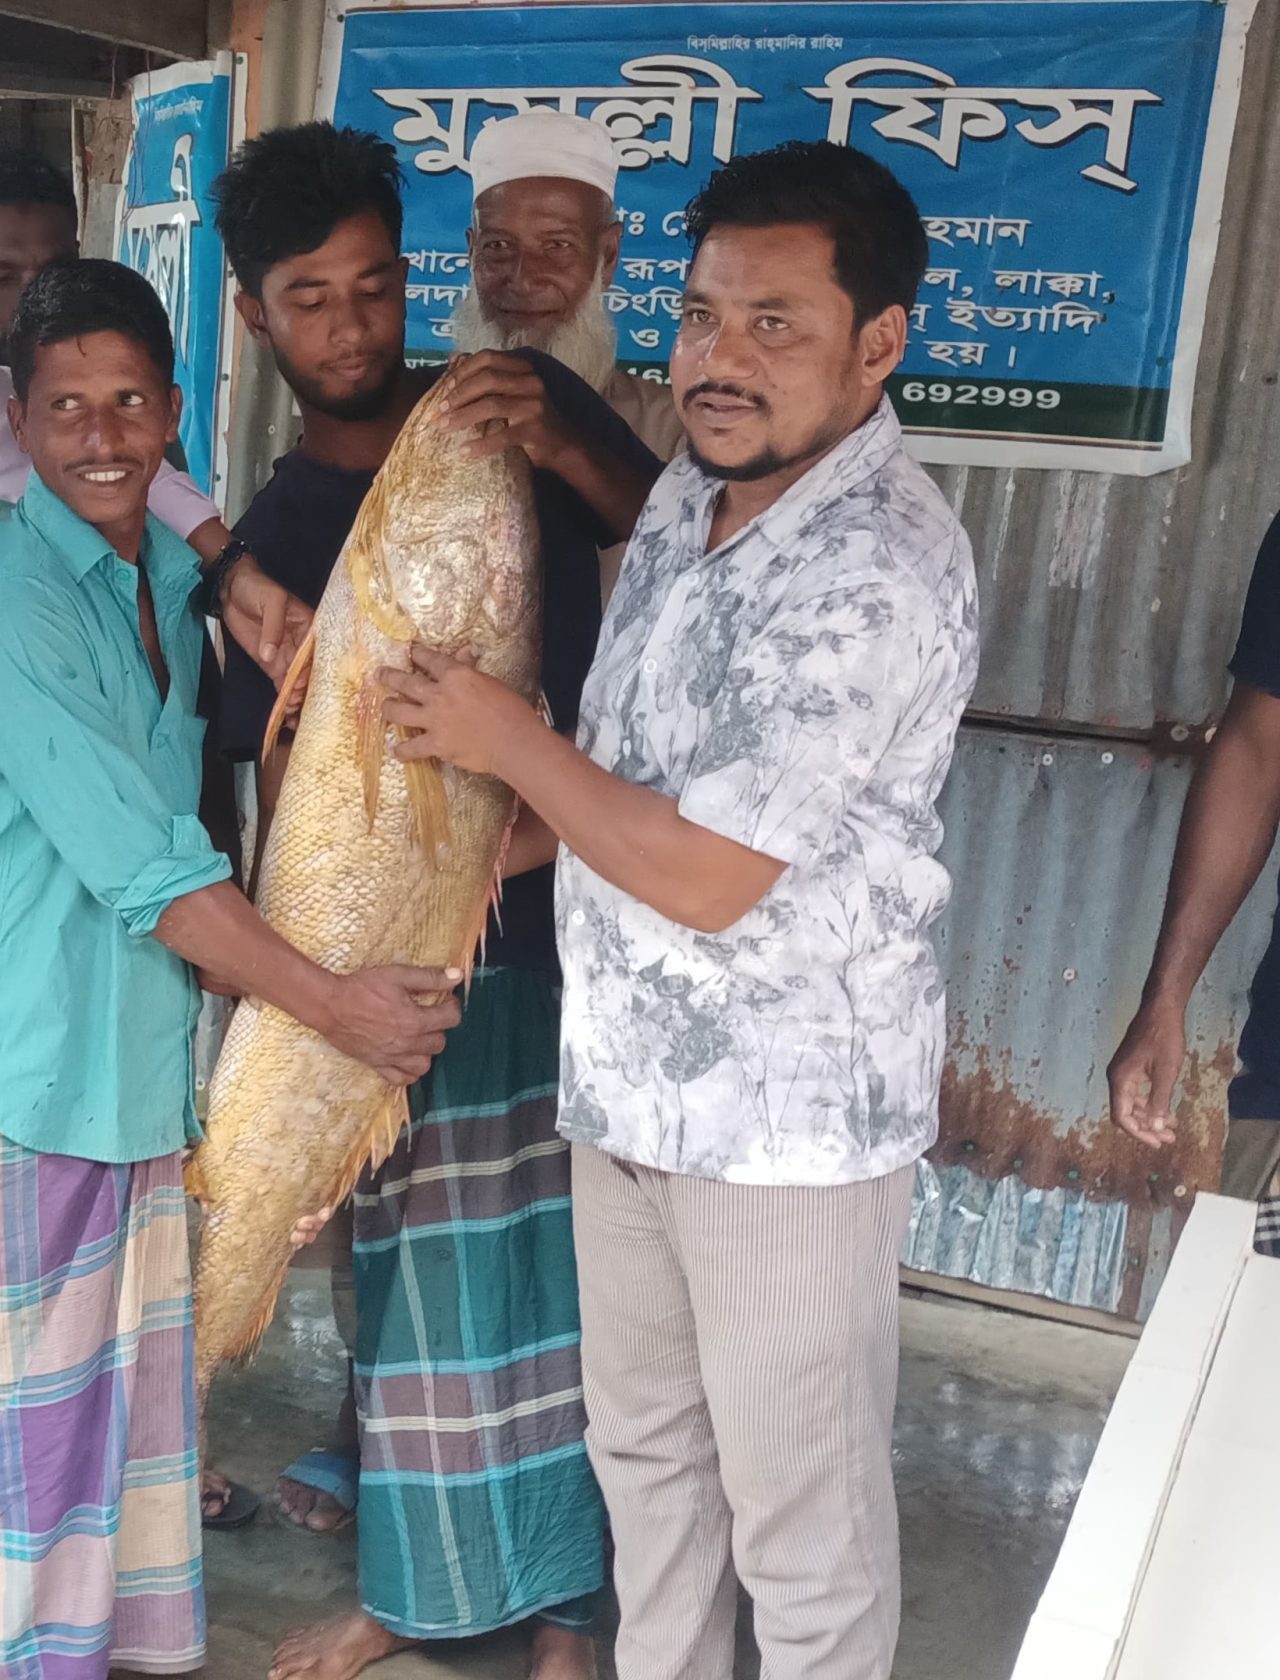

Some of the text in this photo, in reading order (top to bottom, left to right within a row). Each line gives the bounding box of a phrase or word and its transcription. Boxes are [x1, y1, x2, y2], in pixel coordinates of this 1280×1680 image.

[921, 214, 1032, 248] হমান
[629, 329, 659, 348] ও
[902, 382, 1061, 409] 692999
